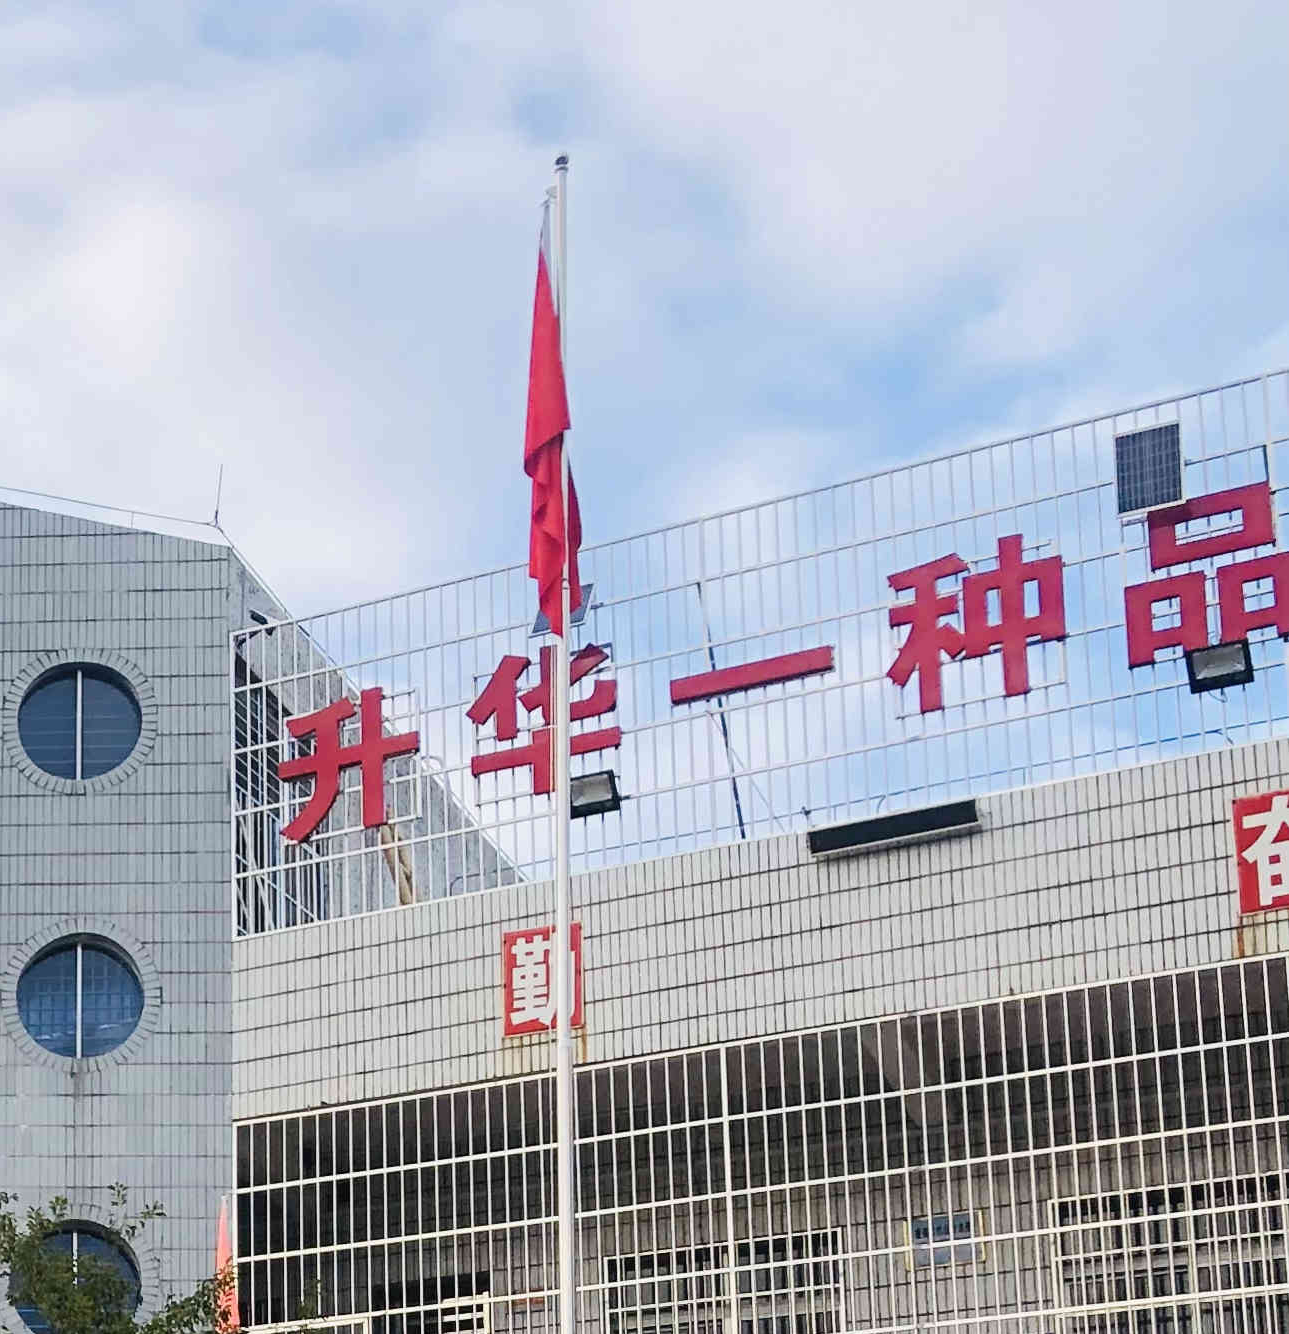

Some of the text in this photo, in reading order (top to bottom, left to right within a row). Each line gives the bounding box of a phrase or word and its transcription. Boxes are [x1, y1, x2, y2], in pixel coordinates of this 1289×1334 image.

[278, 480, 1289, 843] 升华一种品
[510, 935, 576, 1026] 勤
